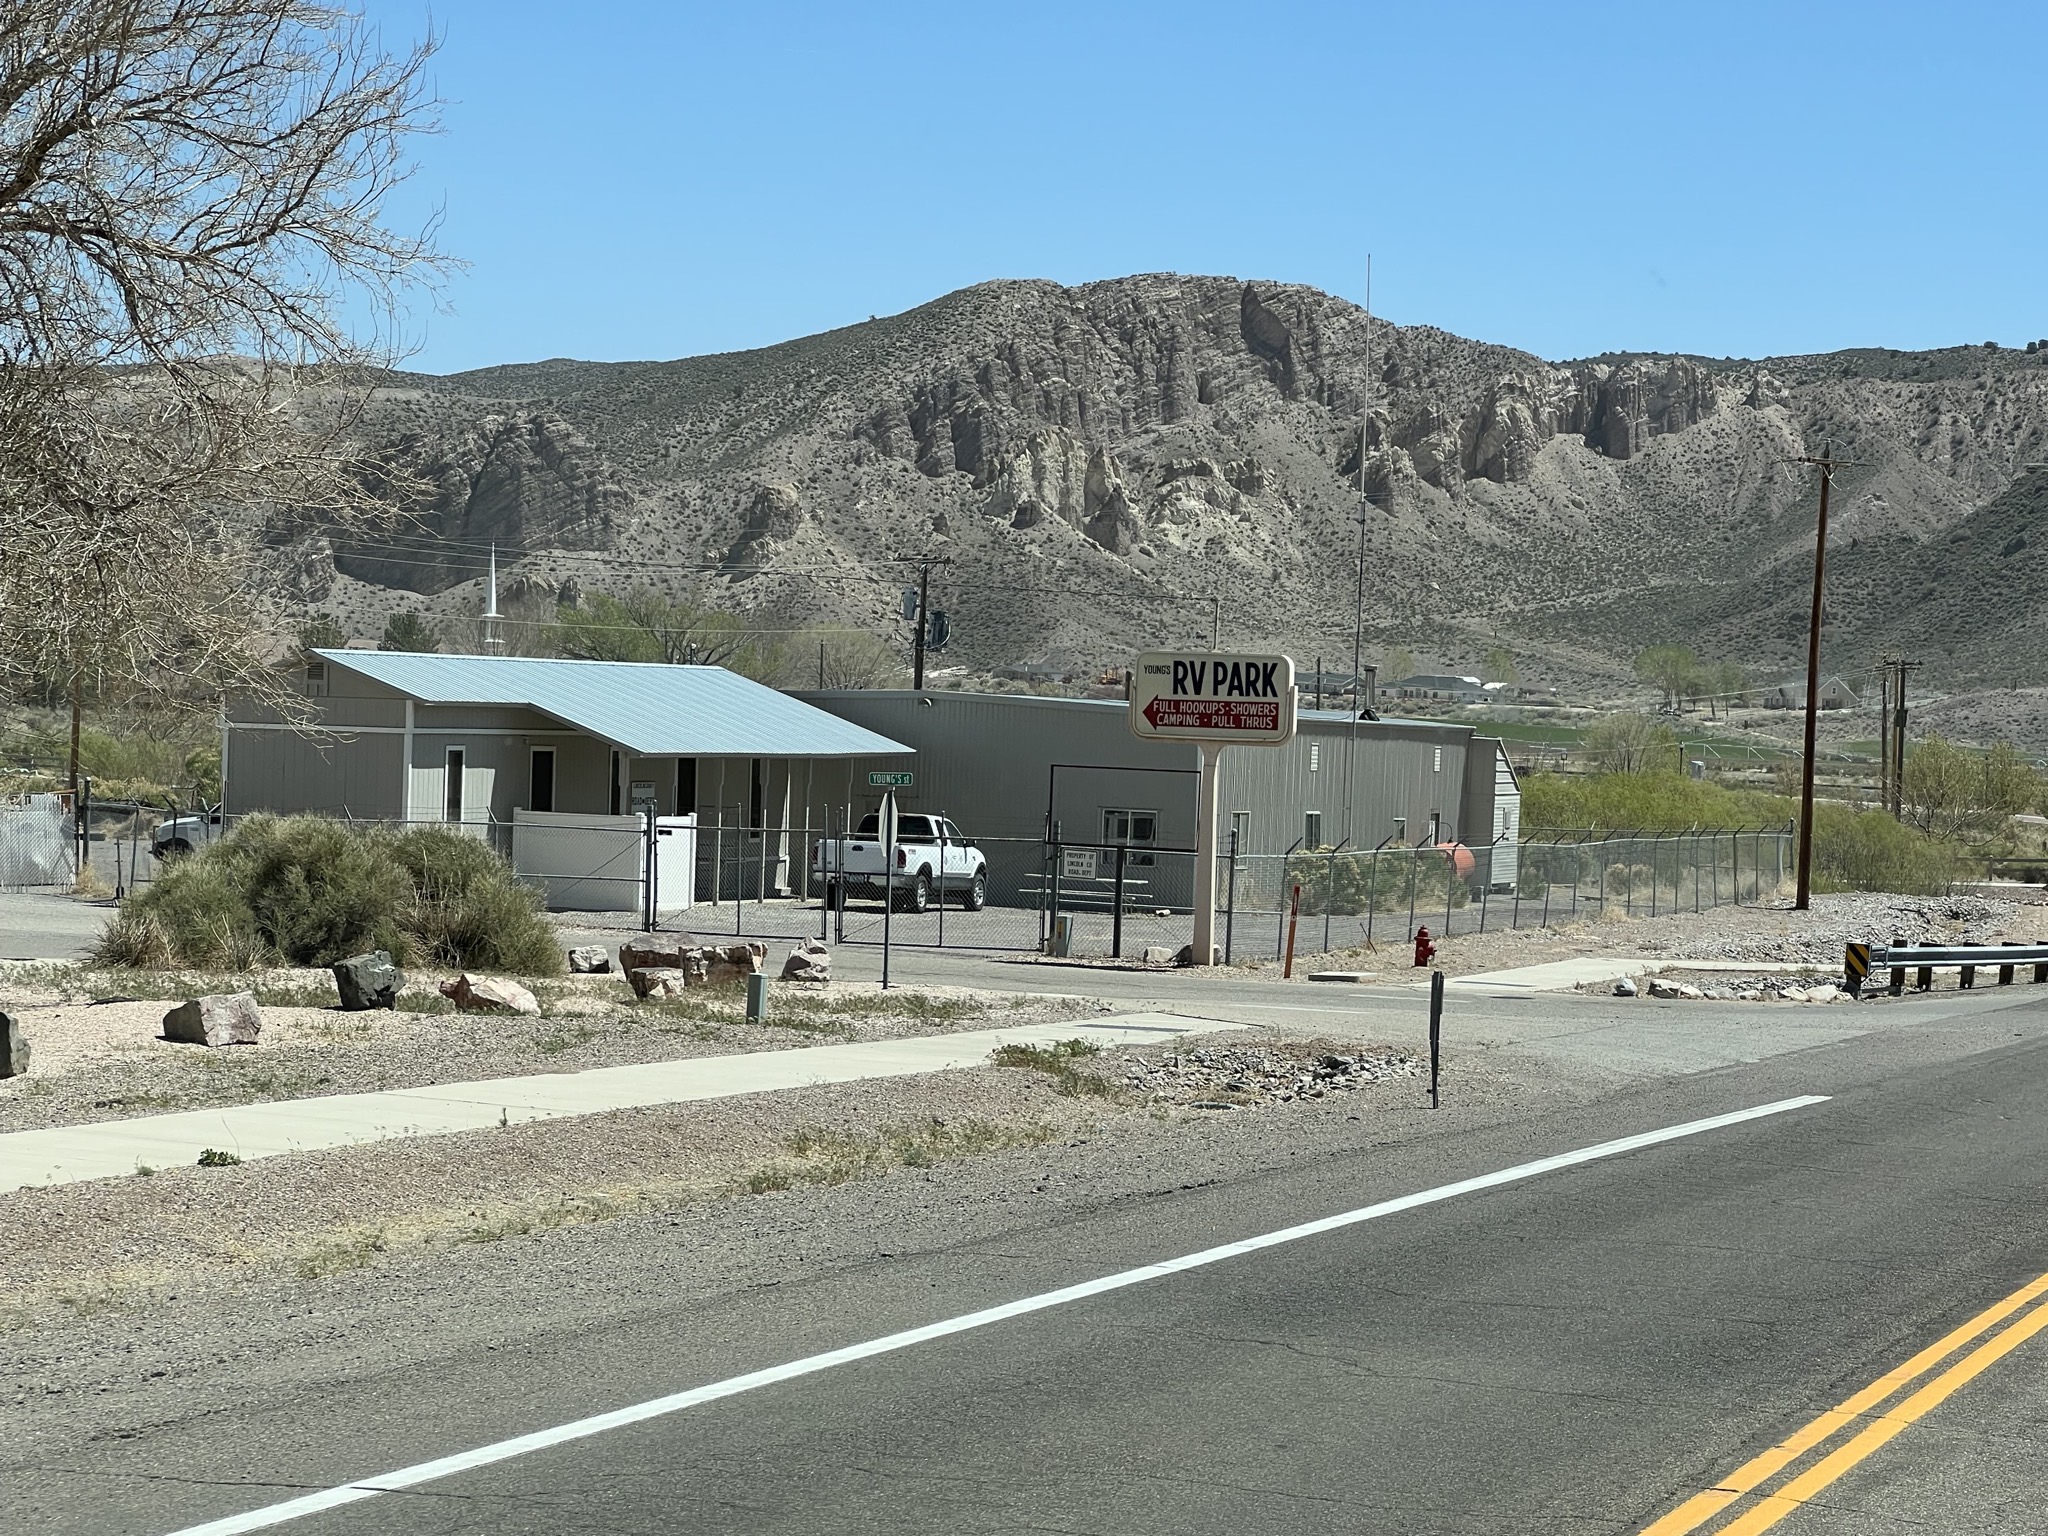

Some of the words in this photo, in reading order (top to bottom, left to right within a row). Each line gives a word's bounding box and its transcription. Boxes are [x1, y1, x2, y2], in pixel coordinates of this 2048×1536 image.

[1143, 664, 1171, 675] YOUNG'S
[1172, 660, 1207, 696] RV
[1212, 661, 1279, 698] PARK
[1153, 700, 1176, 713] FULL
[1179, 701, 1225, 714] HOOKUPS
[1230, 703, 1277, 716] SHOWERS
[1156, 713, 1200, 726] CAMPING
[1211, 716, 1236, 728] PULL
[1240, 716, 1273, 729] THRUS
[872, 774, 902, 784] YOUNG'S
